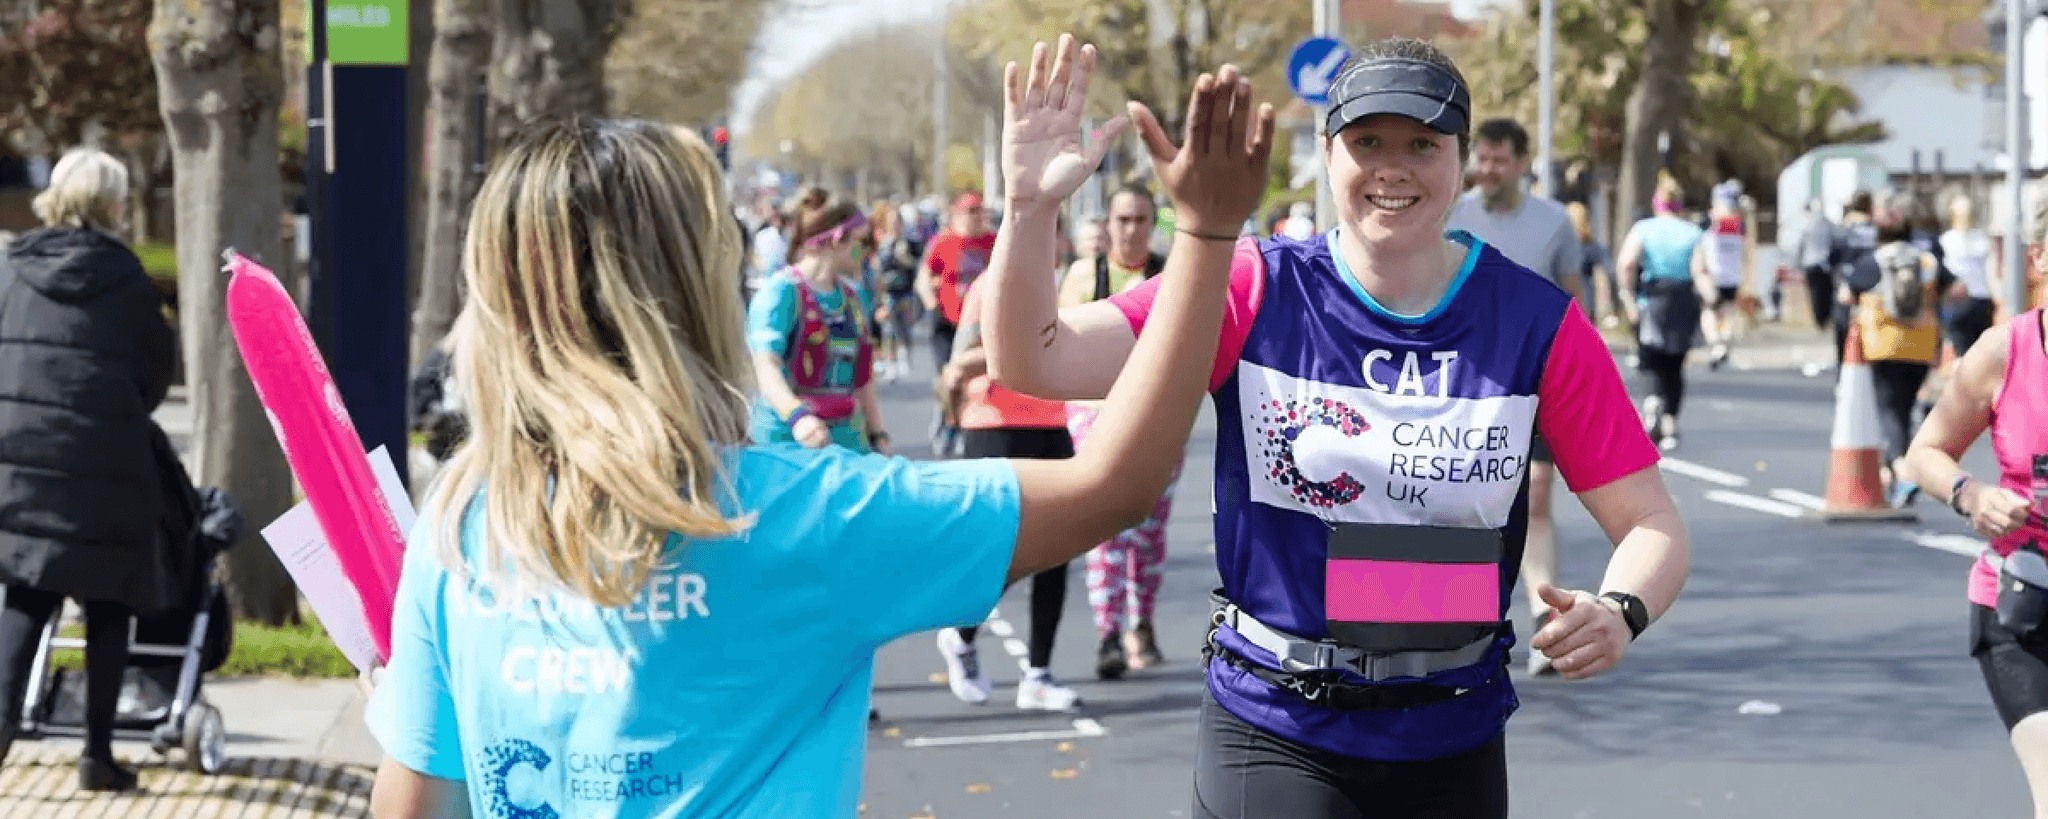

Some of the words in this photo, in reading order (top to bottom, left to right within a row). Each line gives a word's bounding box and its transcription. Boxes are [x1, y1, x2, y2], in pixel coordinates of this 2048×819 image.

[1361, 348, 1458, 398] CAT
[1392, 422, 1508, 450] CANCER
[1389, 453, 1524, 483] RESEARCH
[1386, 481, 1428, 507] UK
[449, 573, 710, 622] VOLUNEER
[503, 646, 630, 694] CREW
[568, 752, 653, 774] CANCER
[571, 772, 683, 800] RESEARCH
